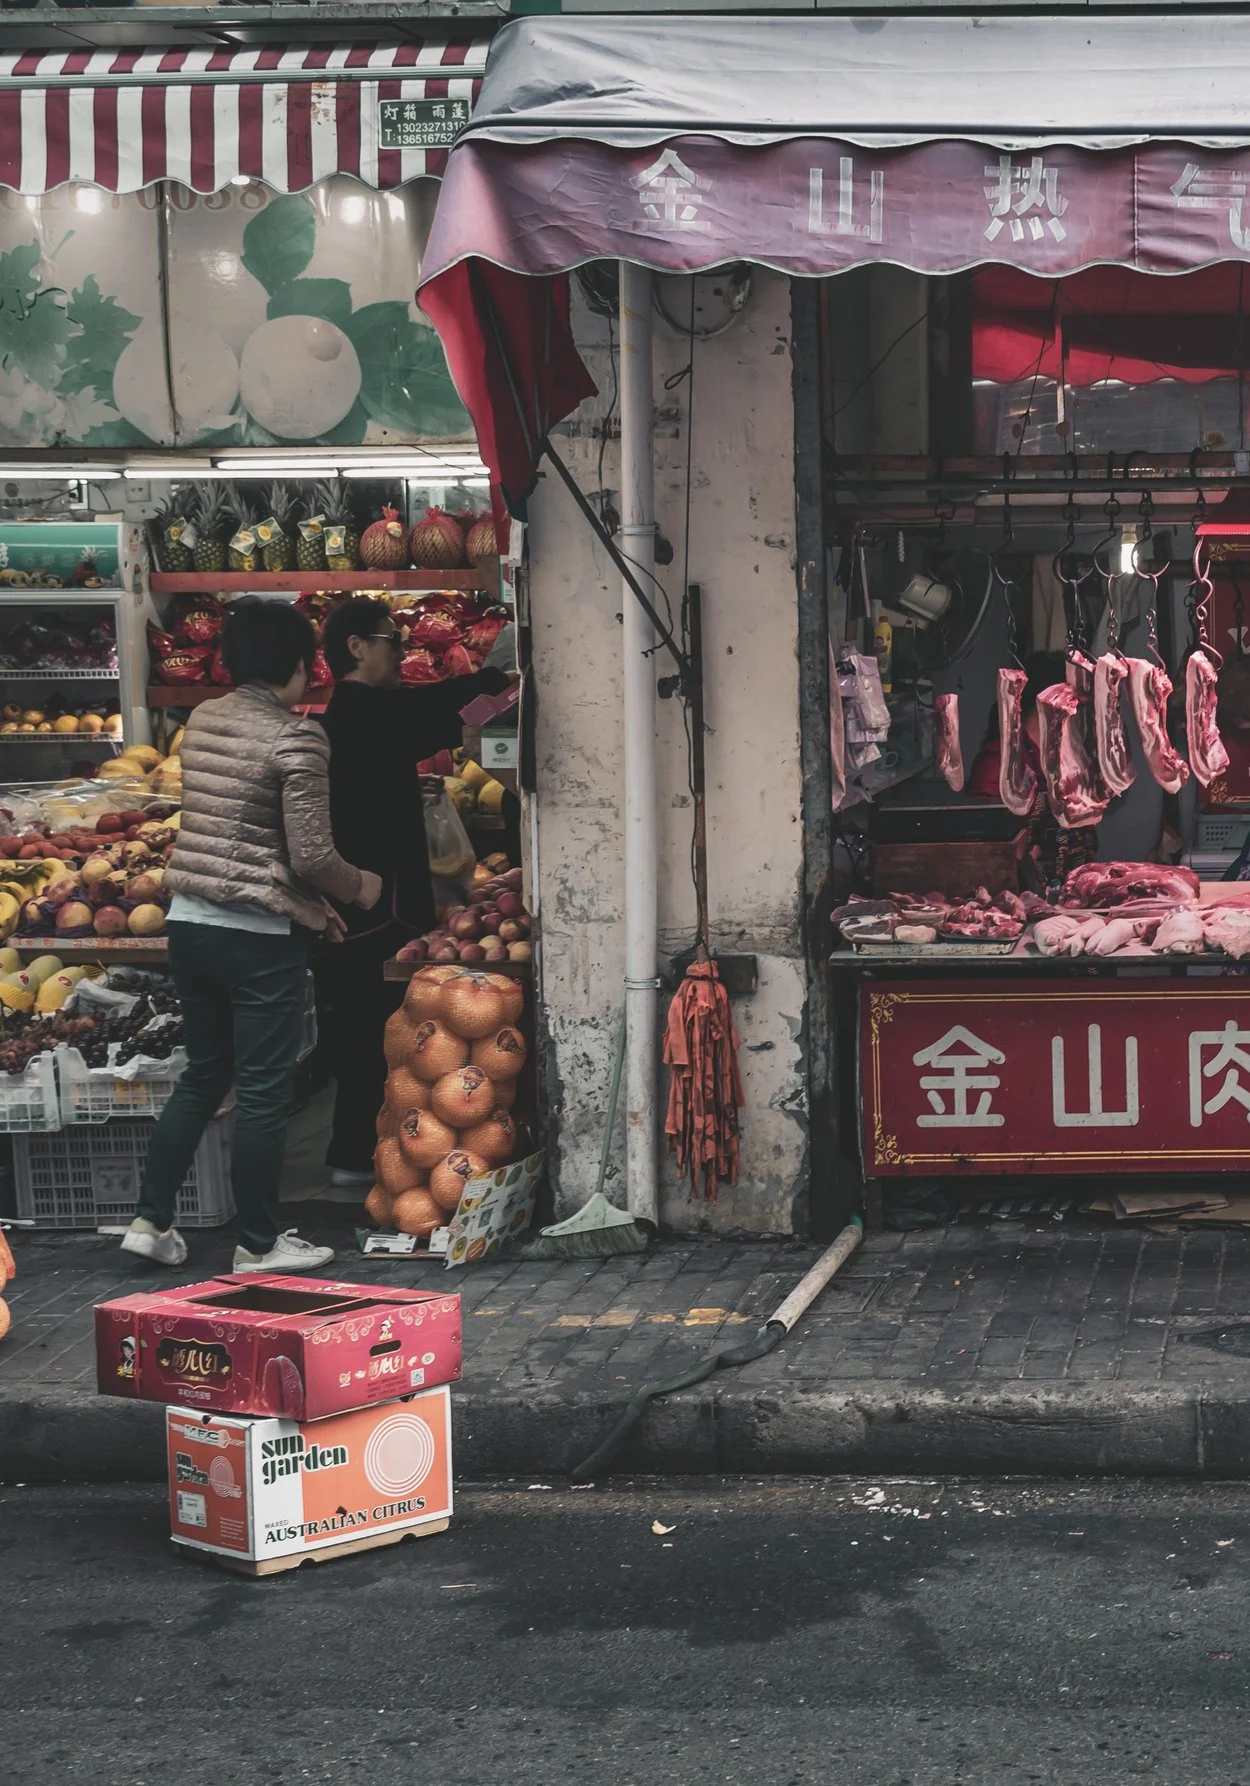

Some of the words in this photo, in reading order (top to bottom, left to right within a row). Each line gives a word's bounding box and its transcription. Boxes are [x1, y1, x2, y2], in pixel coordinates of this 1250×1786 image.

[384, 104, 417, 120] 灯箱
[397, 133, 456, 145] 136516752
[261, 1435, 304, 1459] sun
[262, 1446, 347, 1485] garden
[264, 1511, 367, 1544] AUSTRALIAN
[373, 1496, 425, 1520] CITRUS
[264, 1519, 289, 1529] WAXED
